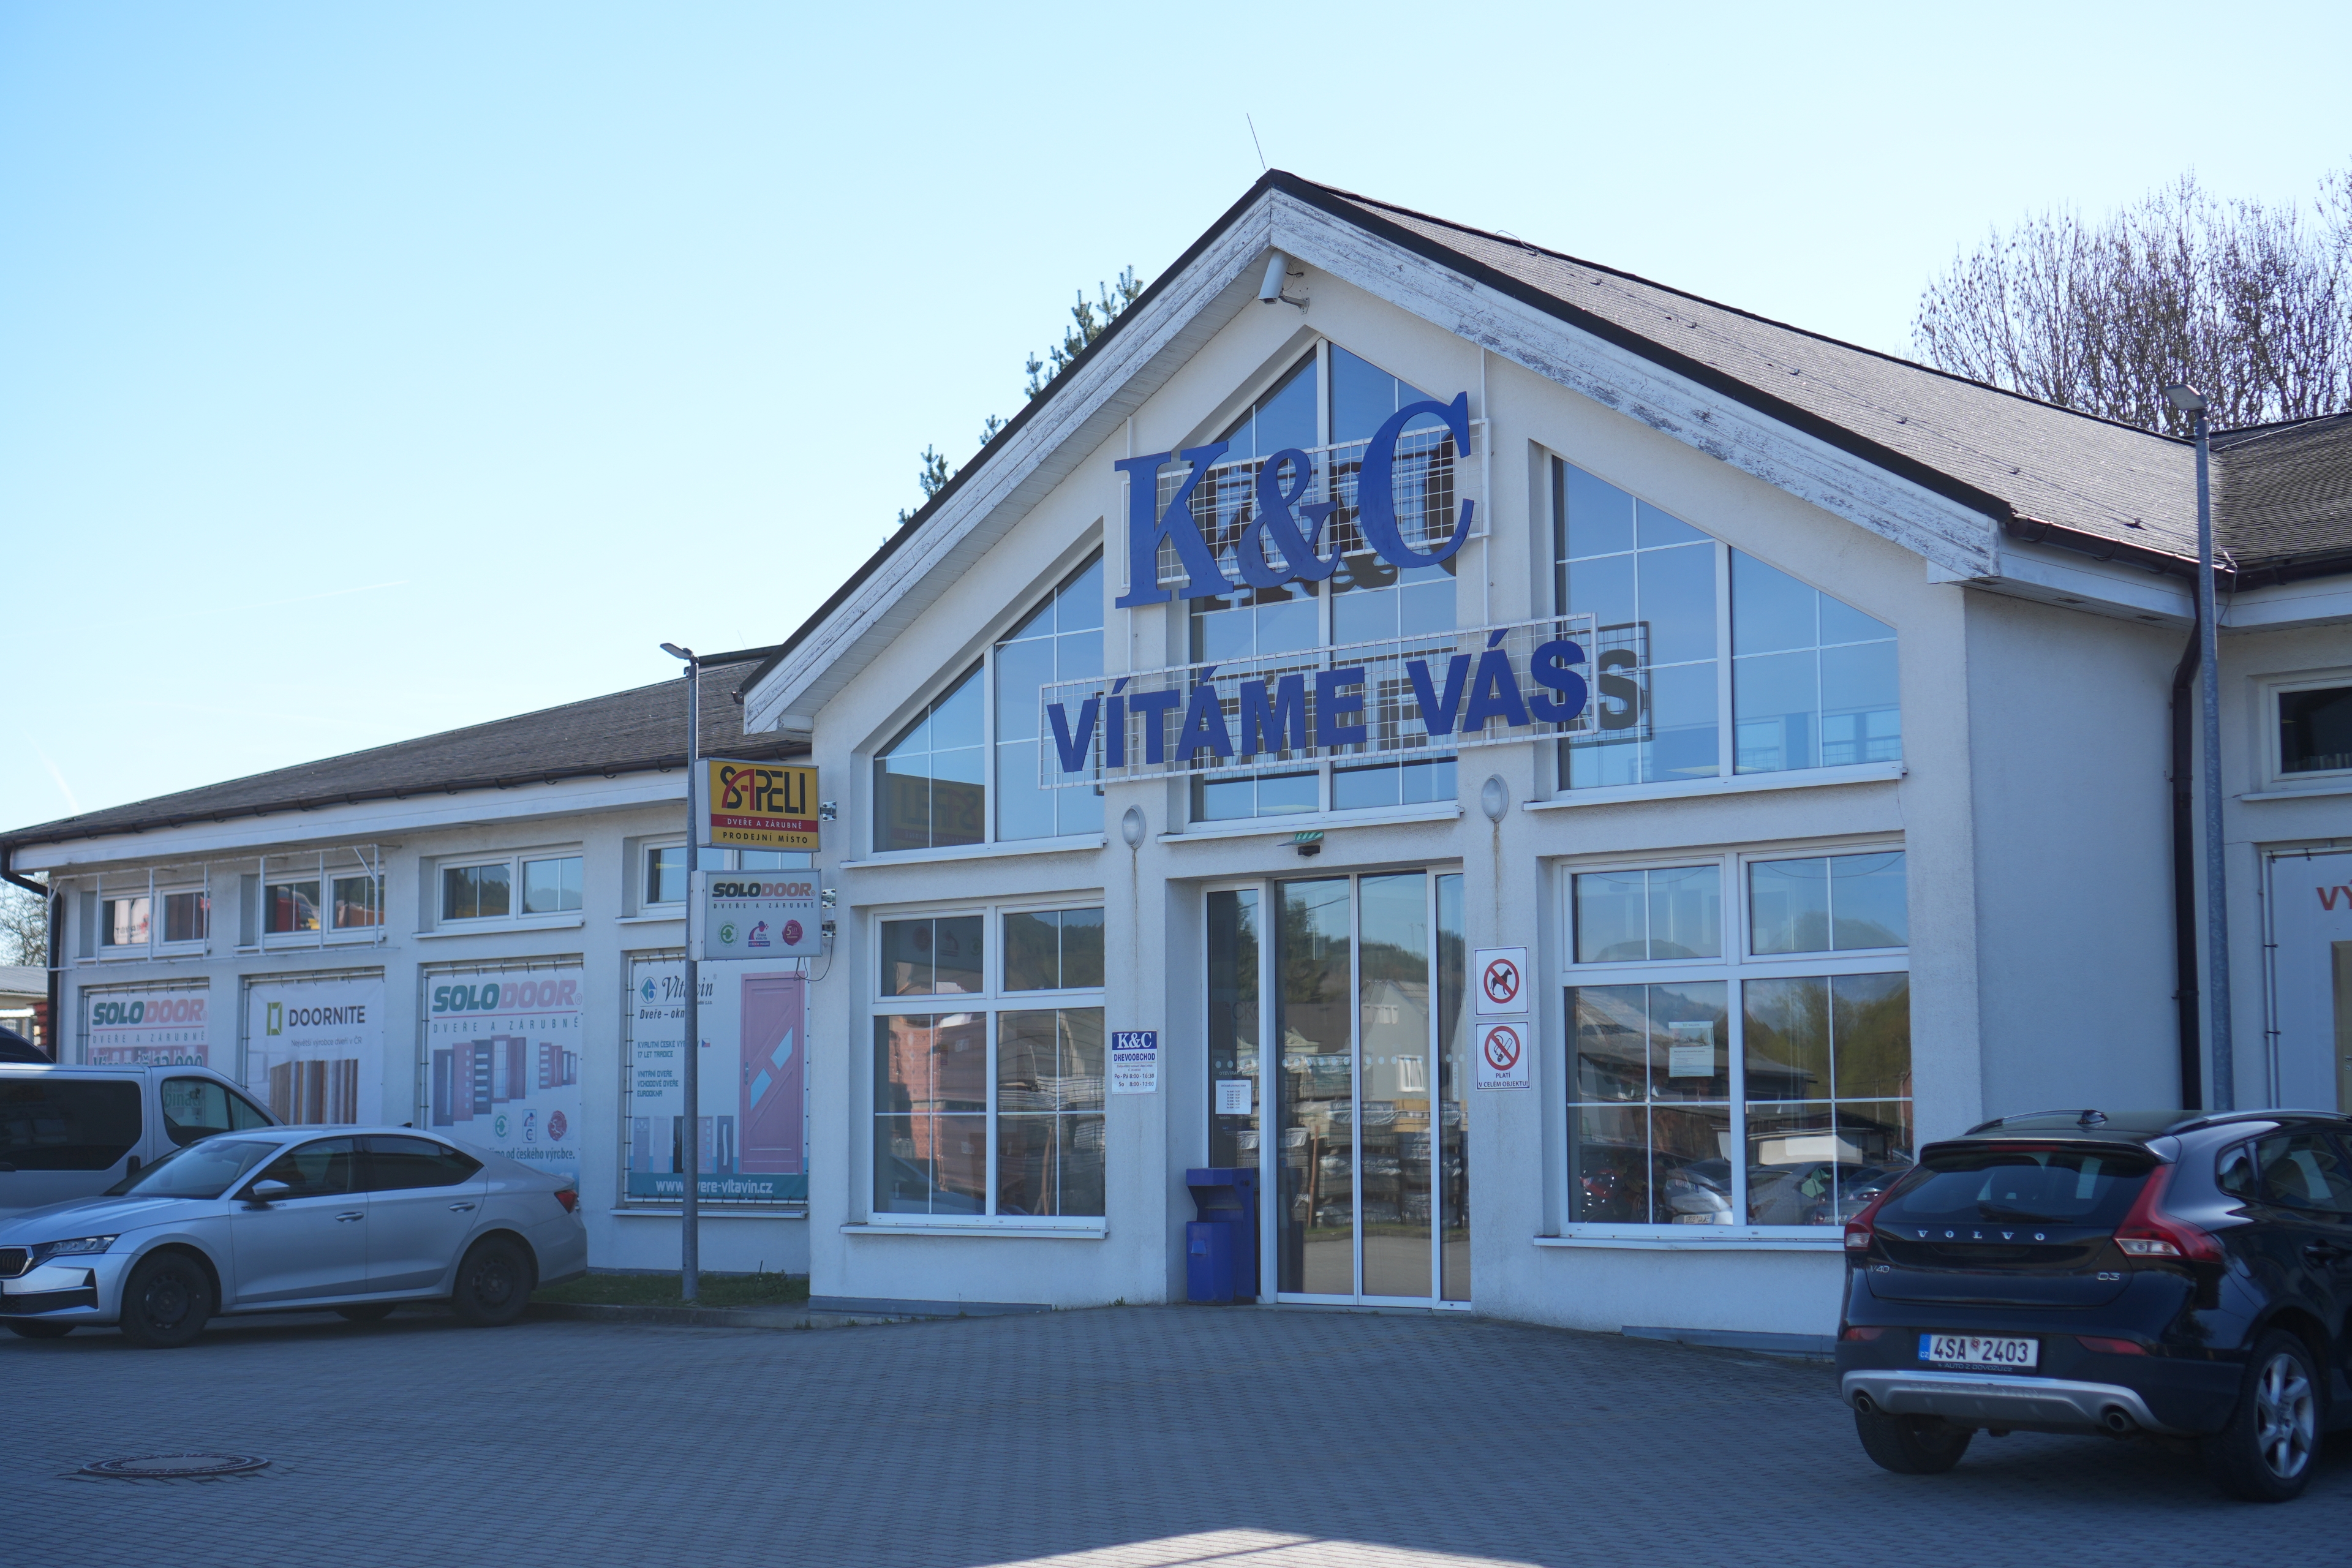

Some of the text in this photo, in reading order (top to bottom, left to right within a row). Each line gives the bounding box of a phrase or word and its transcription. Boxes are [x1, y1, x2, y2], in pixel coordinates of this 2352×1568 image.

[1115, 391, 1474, 608] K&C
[1047, 628, 1588, 772] VÍTÁME VÁS
[720, 766, 805, 814] SAPELI
[727, 818, 752, 826] DVEŘE
[766, 820, 802, 829] ZÁRUBNĚ
[723, 832, 807, 843] PRODEJNÍ MÍSTO
[289, 1005, 366, 1027] DOORNITE
[639, 1009, 662, 1019] Dveře
[671, 1008, 685, 1018] okn
[434, 1016, 578, 1033] DVEŘE A ZÁRUBNĚ
[93, 1033, 126, 1043] DVEŘE
[151, 1031, 204, 1041] ZÁRUBNĚ
[312, 1039, 333, 1047] výrobce
[354, 1036, 362, 1044] ČR
[1117, 1032, 1152, 1049] K&C
[1114, 1053, 1155, 1061] DŘEVOOBCHOD
[516, 1147, 543, 1159] českého
[546, 1148, 575, 1162] výrobce.
[1917, 1230, 2045, 1241] VOLVO
[1870, 1265, 1890, 1273] V40
[2097, 1272, 2120, 1281] D3
[1934, 1338, 1967, 1360] 4SA
[1982, 1341, 2029, 1363] 2403
